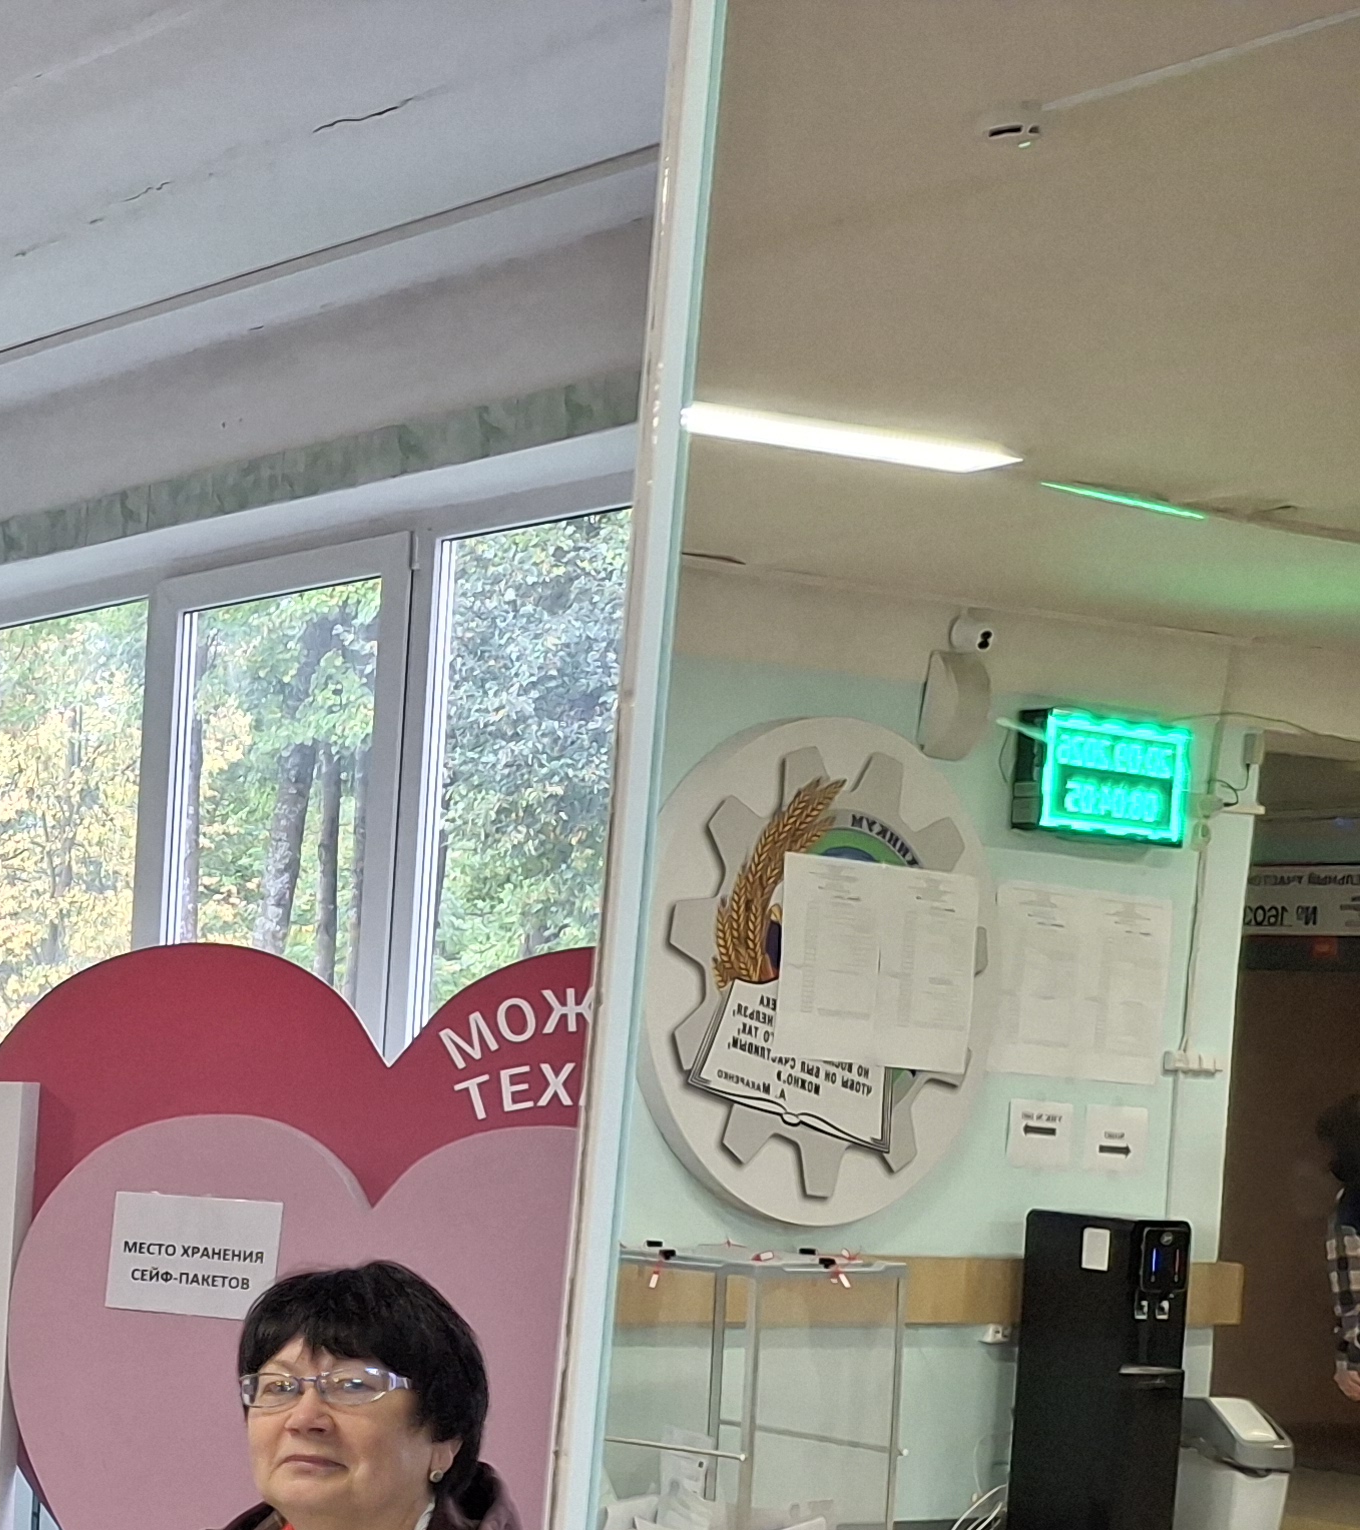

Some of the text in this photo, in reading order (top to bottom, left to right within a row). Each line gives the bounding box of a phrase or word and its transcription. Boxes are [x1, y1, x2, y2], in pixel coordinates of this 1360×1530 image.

[453, 1062, 585, 1121] ТЕХ
[123, 1240, 265, 1264] МЕСТО ХРАНЕНИЯ
[131, 1266, 251, 1290] СЕЙФ-ПАКЕТОВ
